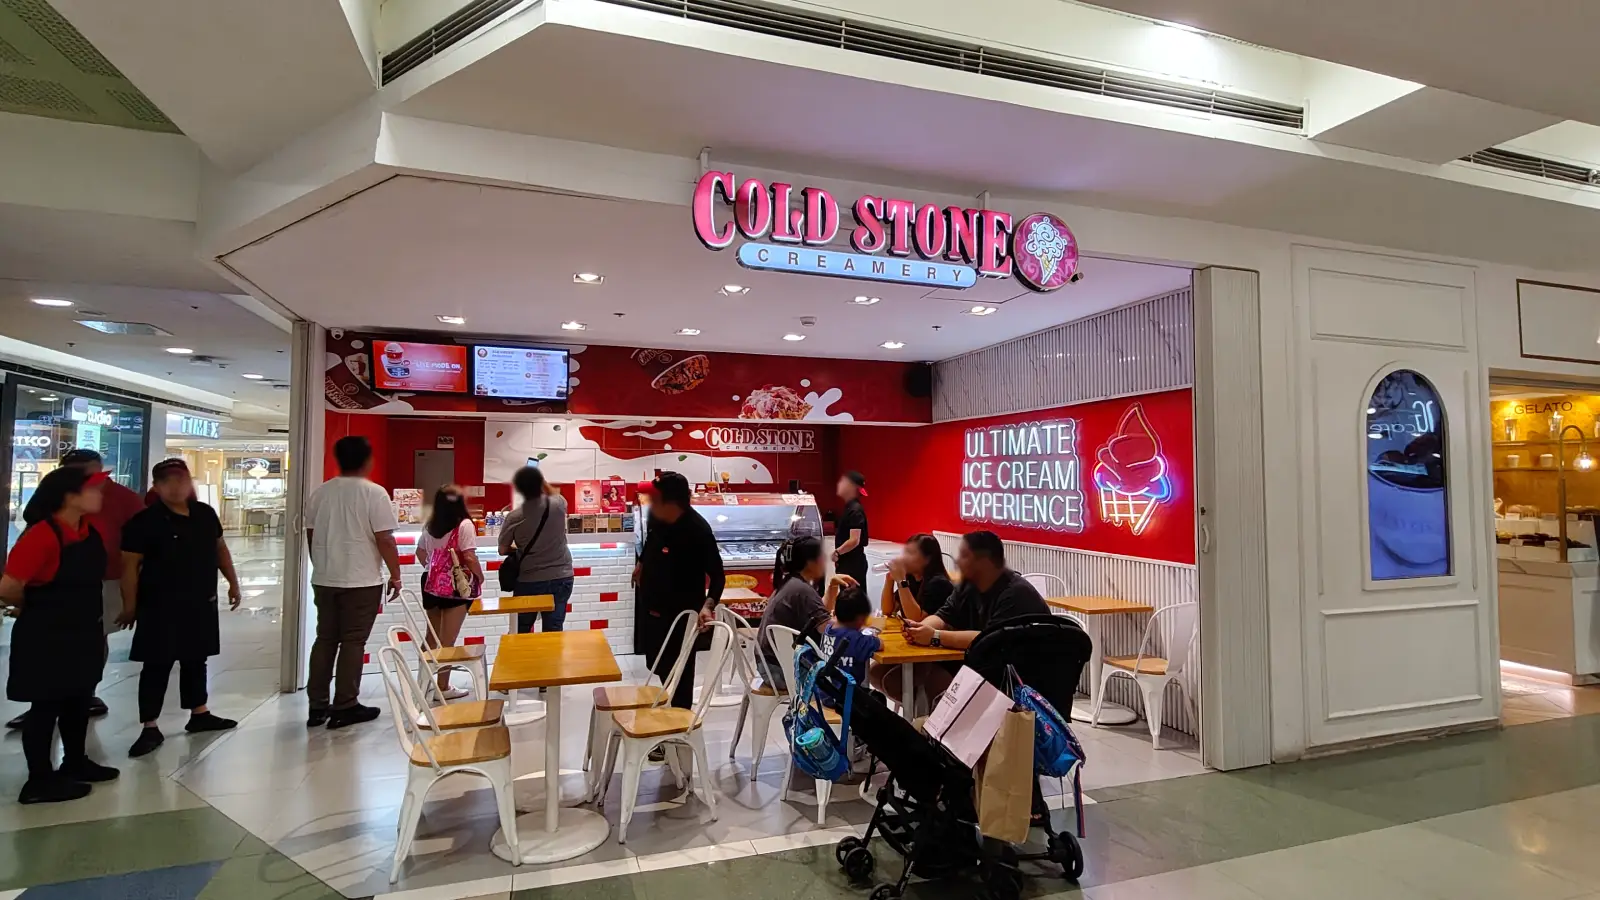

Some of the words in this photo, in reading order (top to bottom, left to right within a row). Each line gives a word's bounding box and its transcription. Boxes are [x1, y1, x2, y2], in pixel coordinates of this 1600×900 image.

[692, 170, 840, 250] COLD
[850, 195, 1015, 279] STONE
[757, 248, 962, 282] CREAMERY
[1514, 401, 1573, 414] GELATO
[180, 416, 219, 439] TIMEX
[705, 427, 755, 449] COLD
[755, 428, 814, 450] STONE
[966, 424, 1073, 458] ULTIMATE
[964, 461, 992, 488] ICE
[998, 460, 1075, 490] CREAM
[961, 491, 1081, 527] EXPERIENCE
[823, 644, 834, 655] TO
